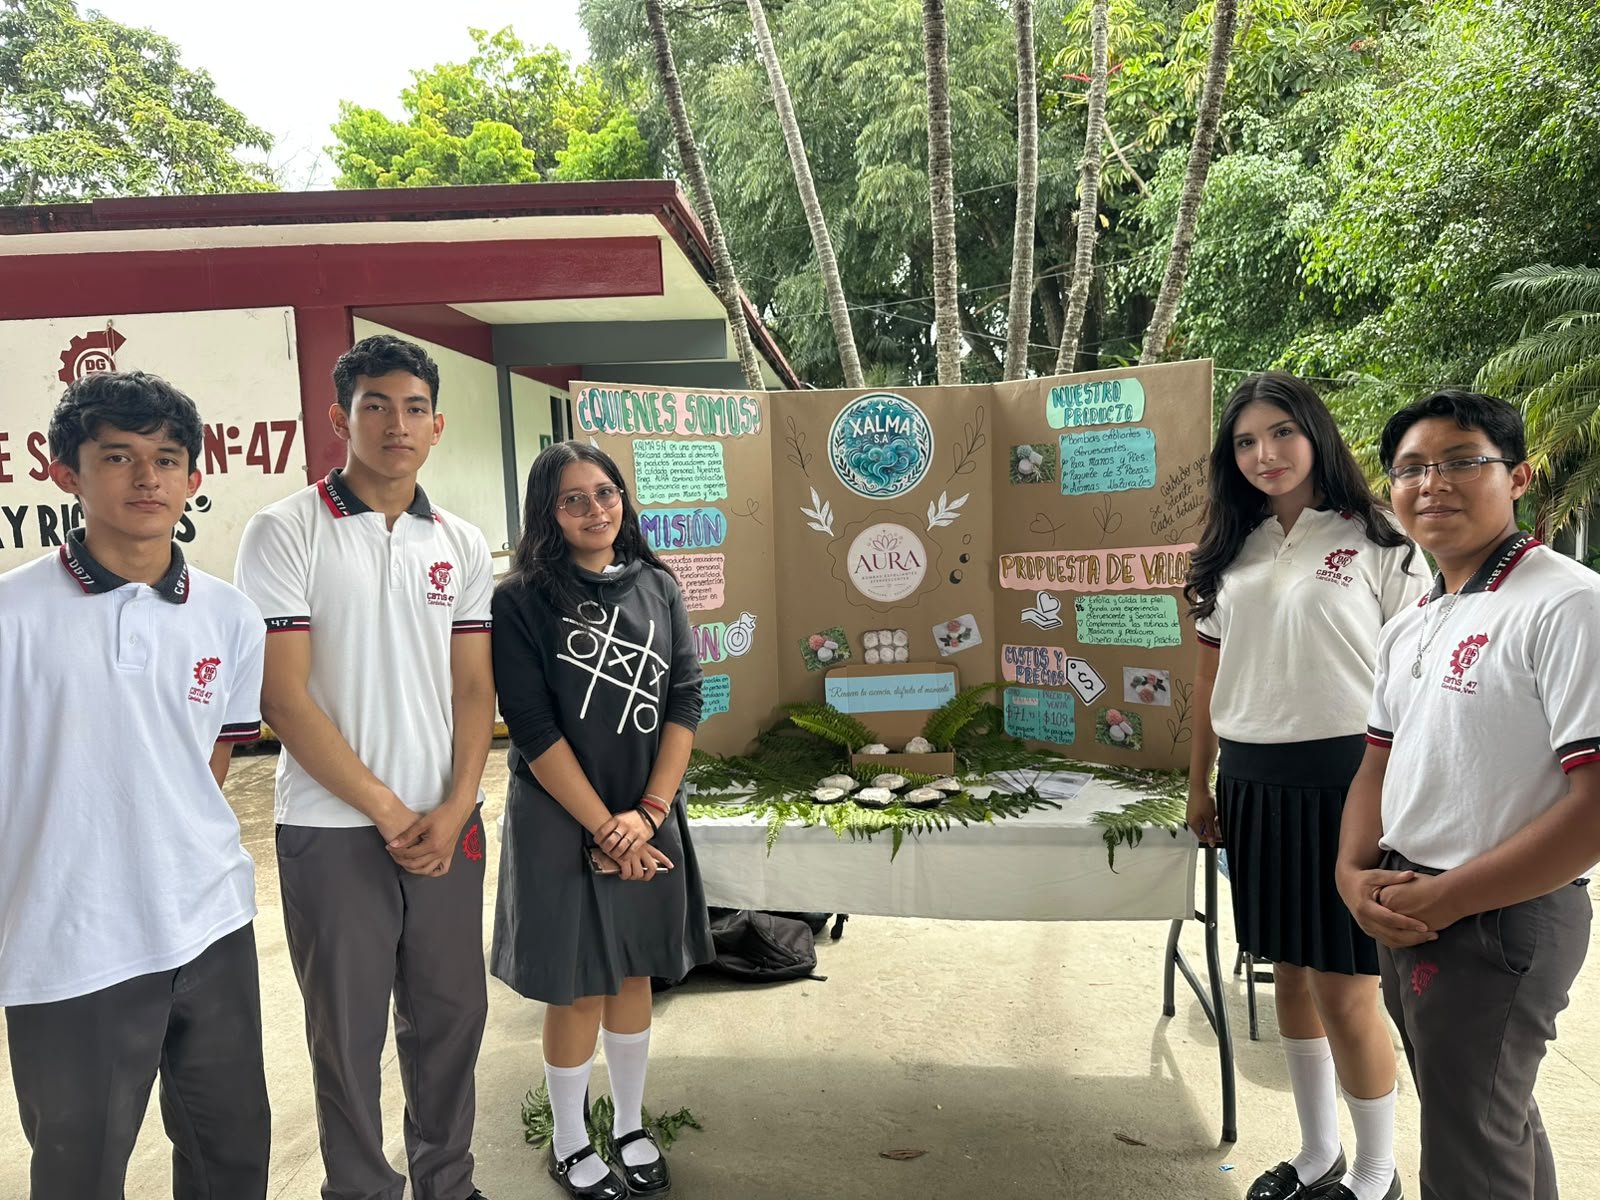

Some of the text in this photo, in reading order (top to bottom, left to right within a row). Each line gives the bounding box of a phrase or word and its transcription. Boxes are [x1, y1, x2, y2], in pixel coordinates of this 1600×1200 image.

[85, 358, 106, 371] DG
[1052, 380, 1121, 407] NUESTRO
[1064, 404, 1133, 426] PRODUCTO
[848, 415, 910, 438] XALMA
[1068, 432, 1100, 445] Bombas
[1069, 456, 1085, 469] Para
[1103, 467, 1113, 478] de
[640, 508, 722, 548] MISIÓN
[854, 550, 921, 574] AURA
[1001, 554, 1101, 585] PROPUESTA
[1107, 552, 1136, 585] DE
[1342, 575, 1354, 583] 47
[271, 619, 288, 627] 47
[1005, 646, 1063, 670] COSTOS Y
[1015, 665, 1065, 686] PRECIOS
[1466, 680, 1478, 689] 47
